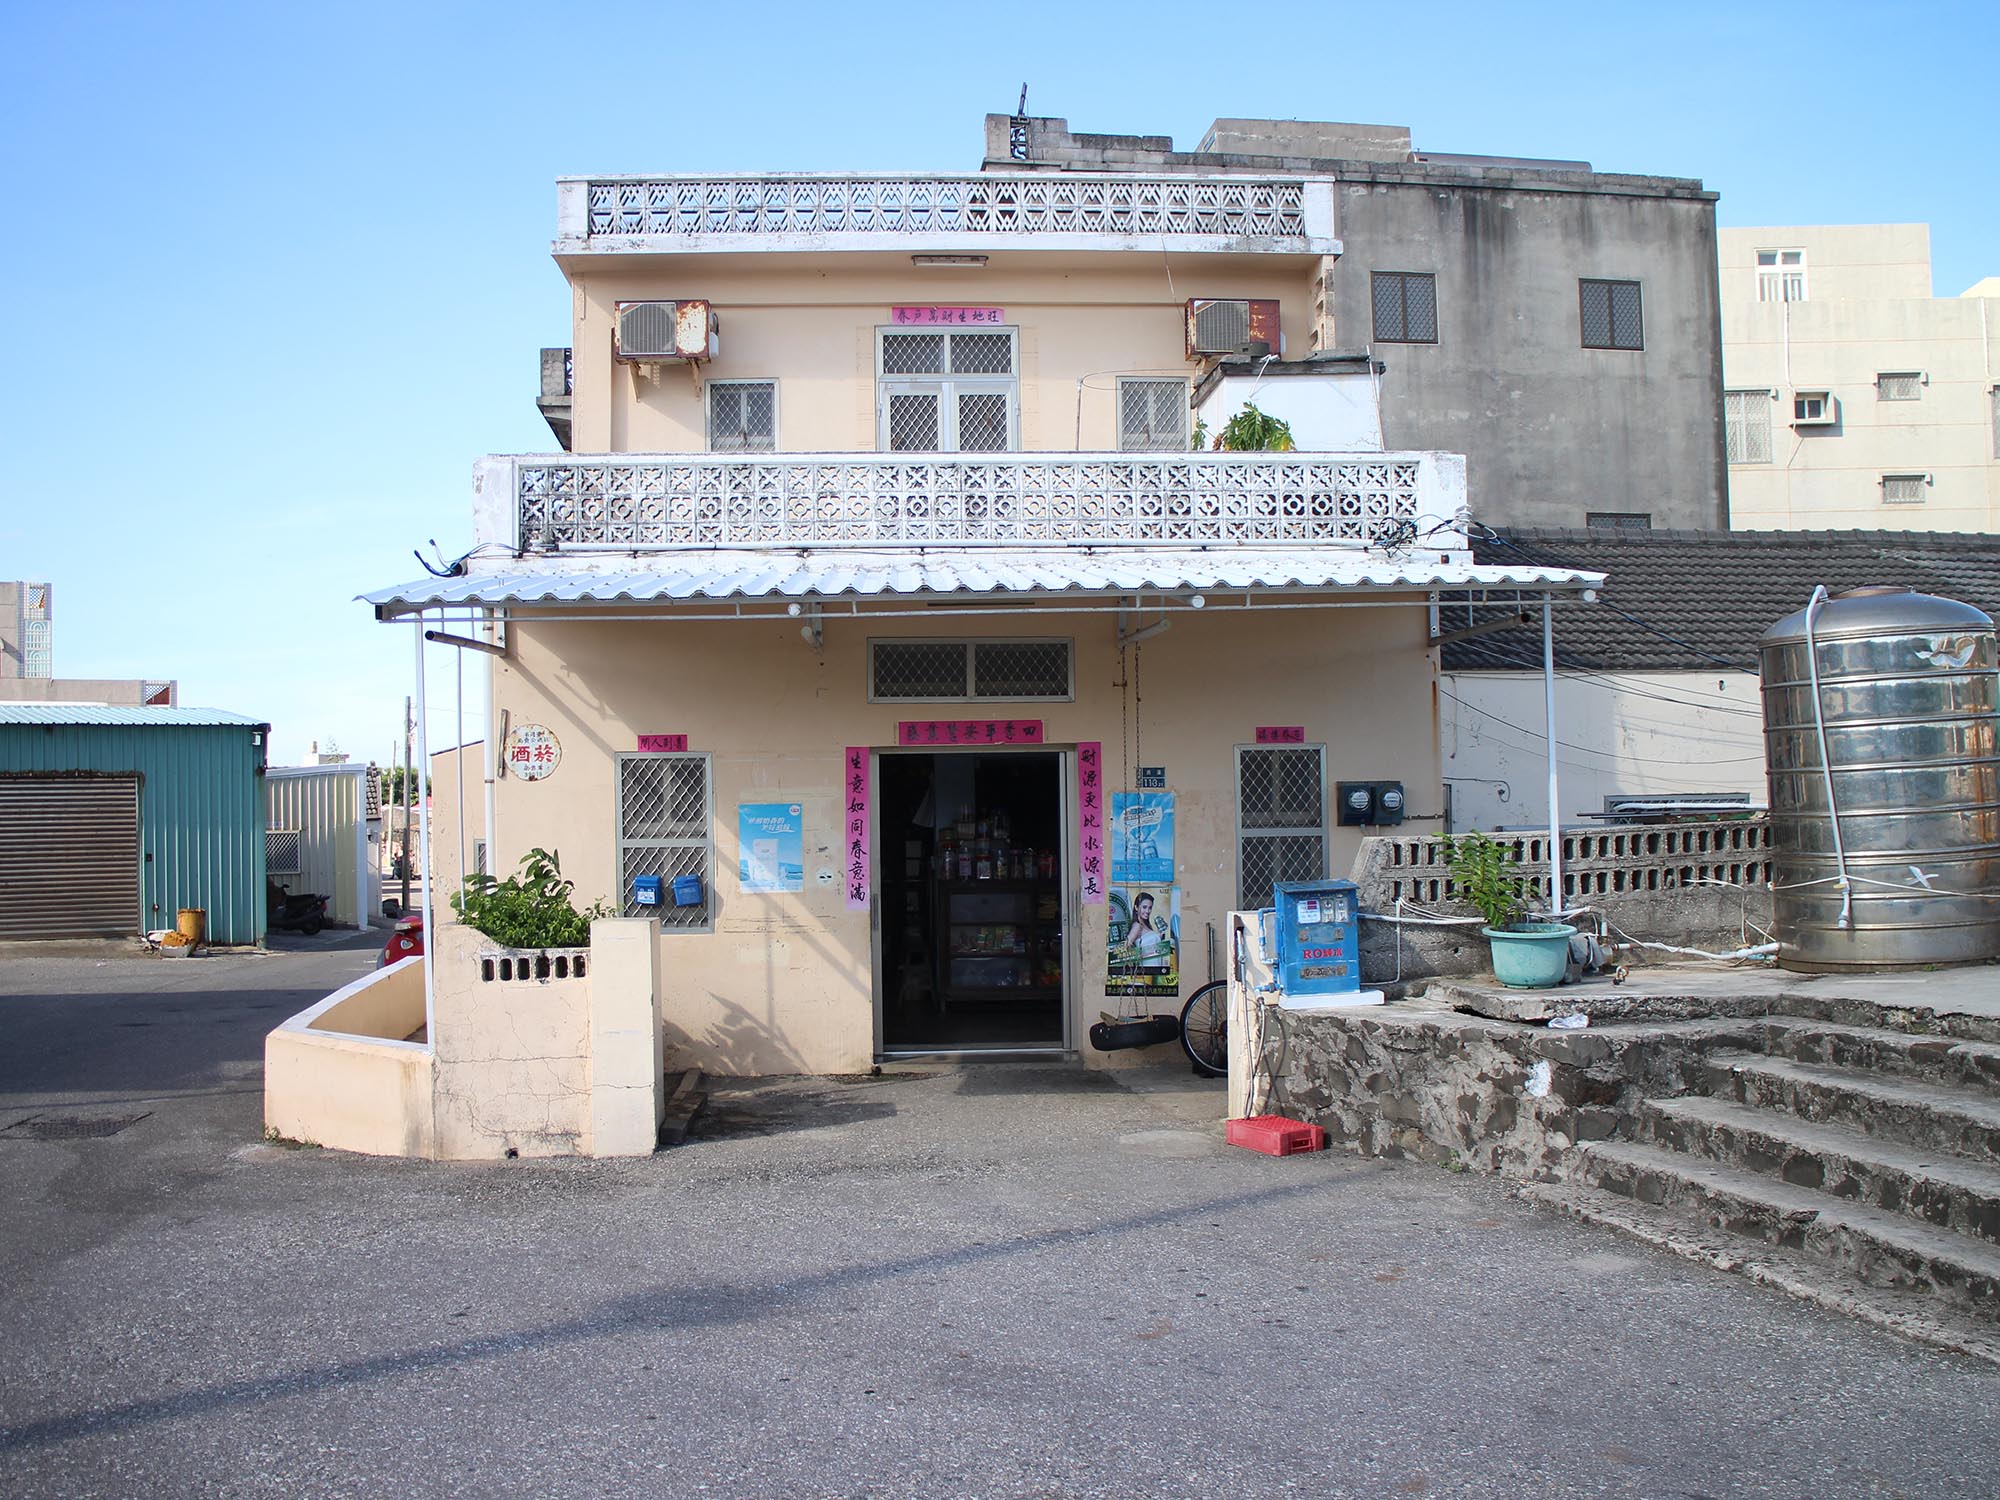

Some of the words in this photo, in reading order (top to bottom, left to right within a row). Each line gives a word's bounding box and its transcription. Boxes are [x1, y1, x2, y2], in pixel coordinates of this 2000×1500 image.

[848, 751, 868, 902] 生意如同春意滿
[1080, 749, 1100, 896] 財源更比水源長
